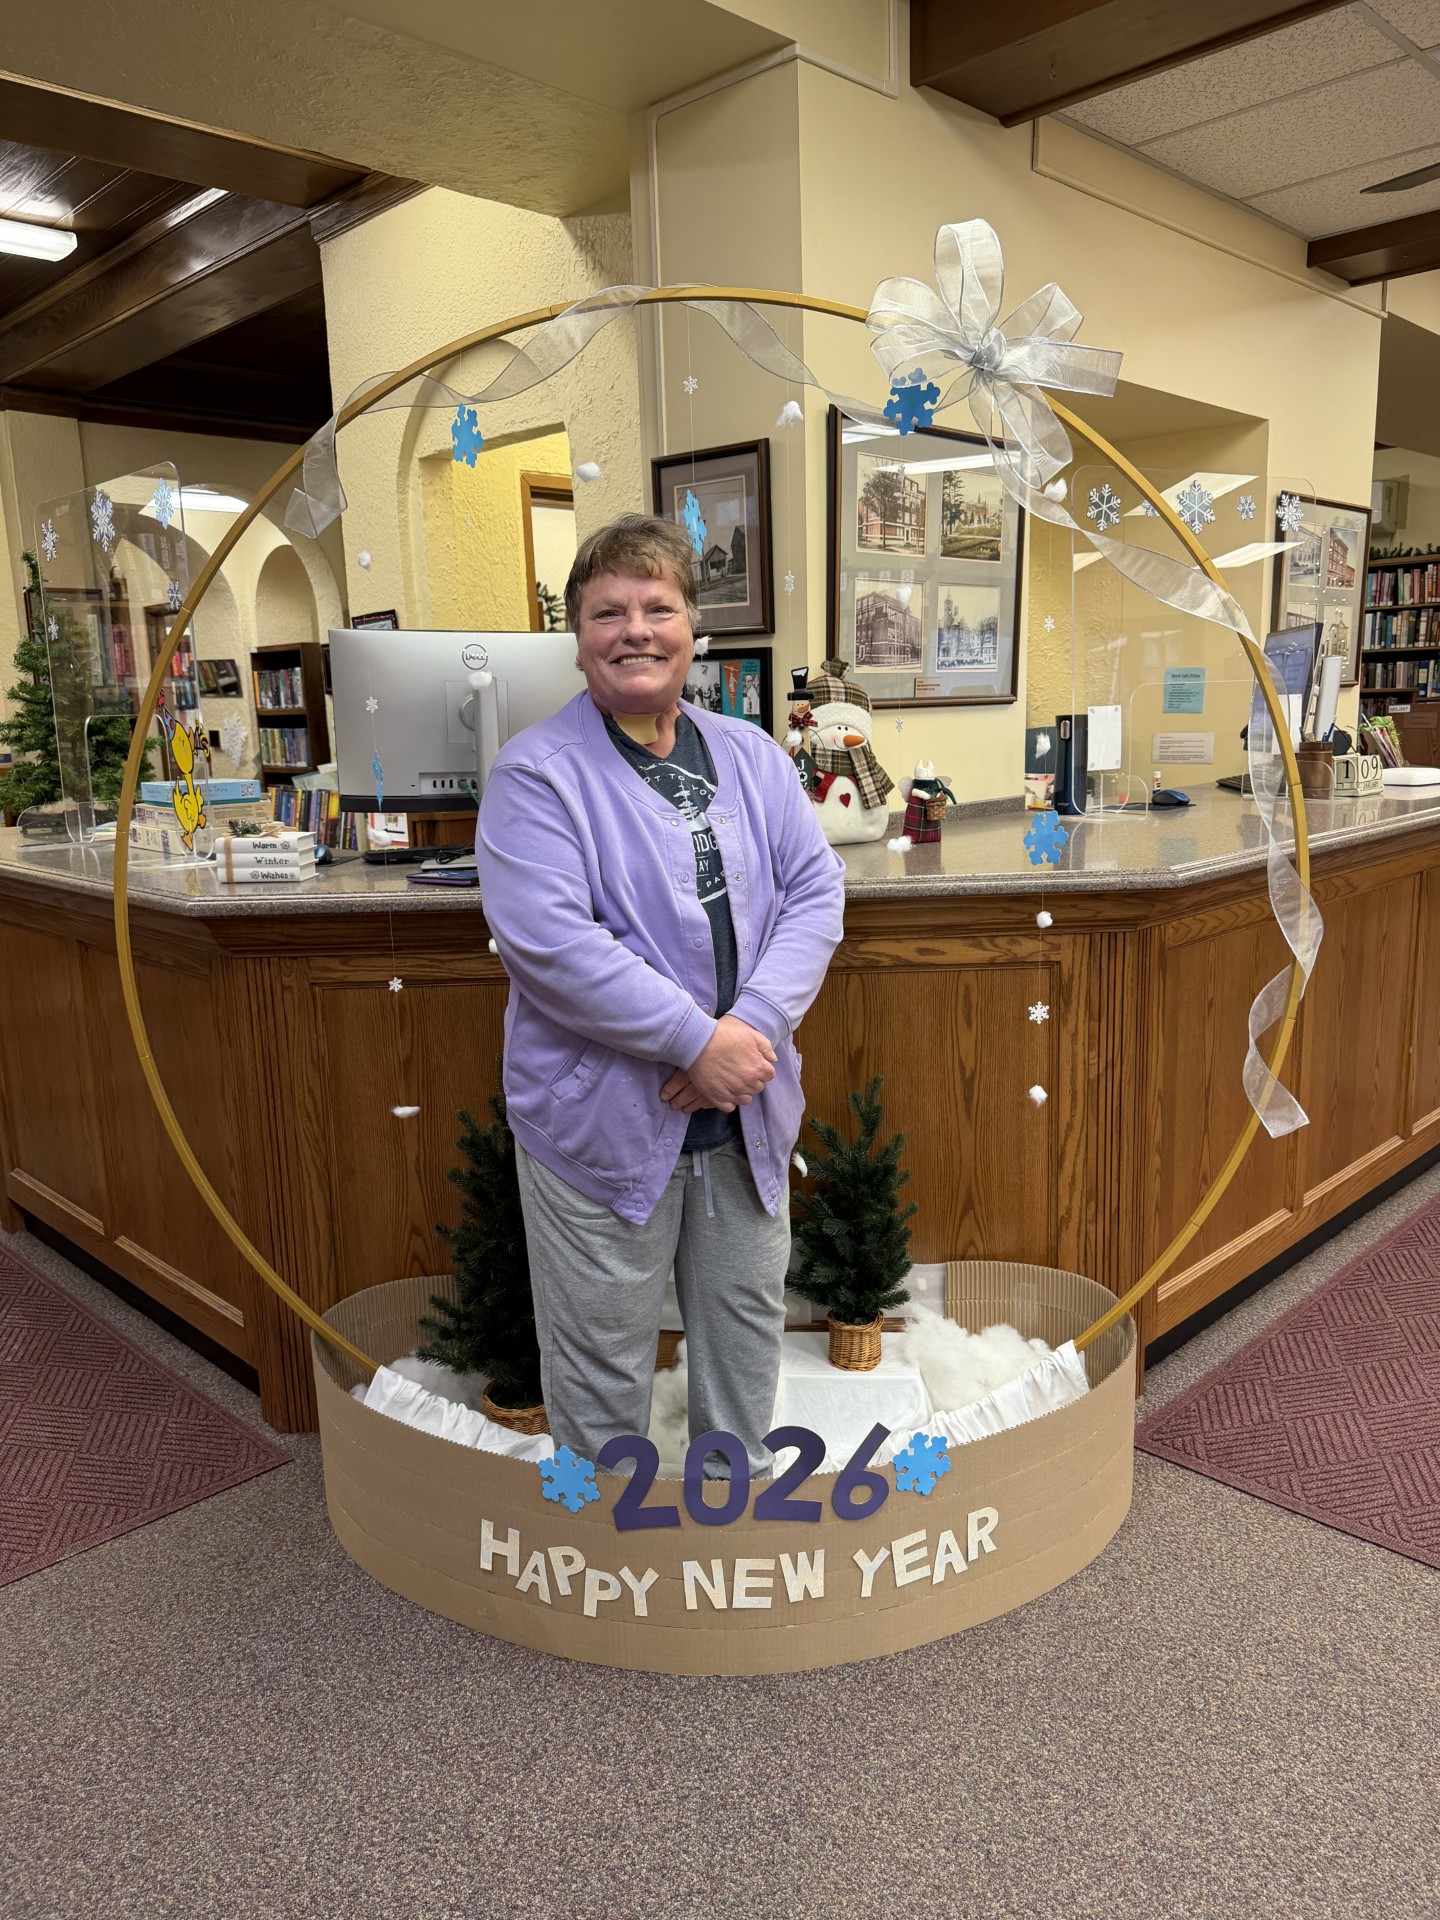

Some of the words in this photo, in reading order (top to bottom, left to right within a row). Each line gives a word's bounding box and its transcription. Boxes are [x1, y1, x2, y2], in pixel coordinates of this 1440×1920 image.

[465, 653, 486, 661] DELL
[1361, 755, 1379, 779] 09
[643, 775, 661, 784] OT
[694, 832, 719, 852] IDG
[254, 856, 290, 865] Winter
[698, 860, 709, 872] AY
[596, 1422, 891, 1531] 2026
[479, 1518, 660, 1618] HAPPY
[683, 1549, 826, 1611] NEW
[853, 1506, 1000, 1598] YEAR
